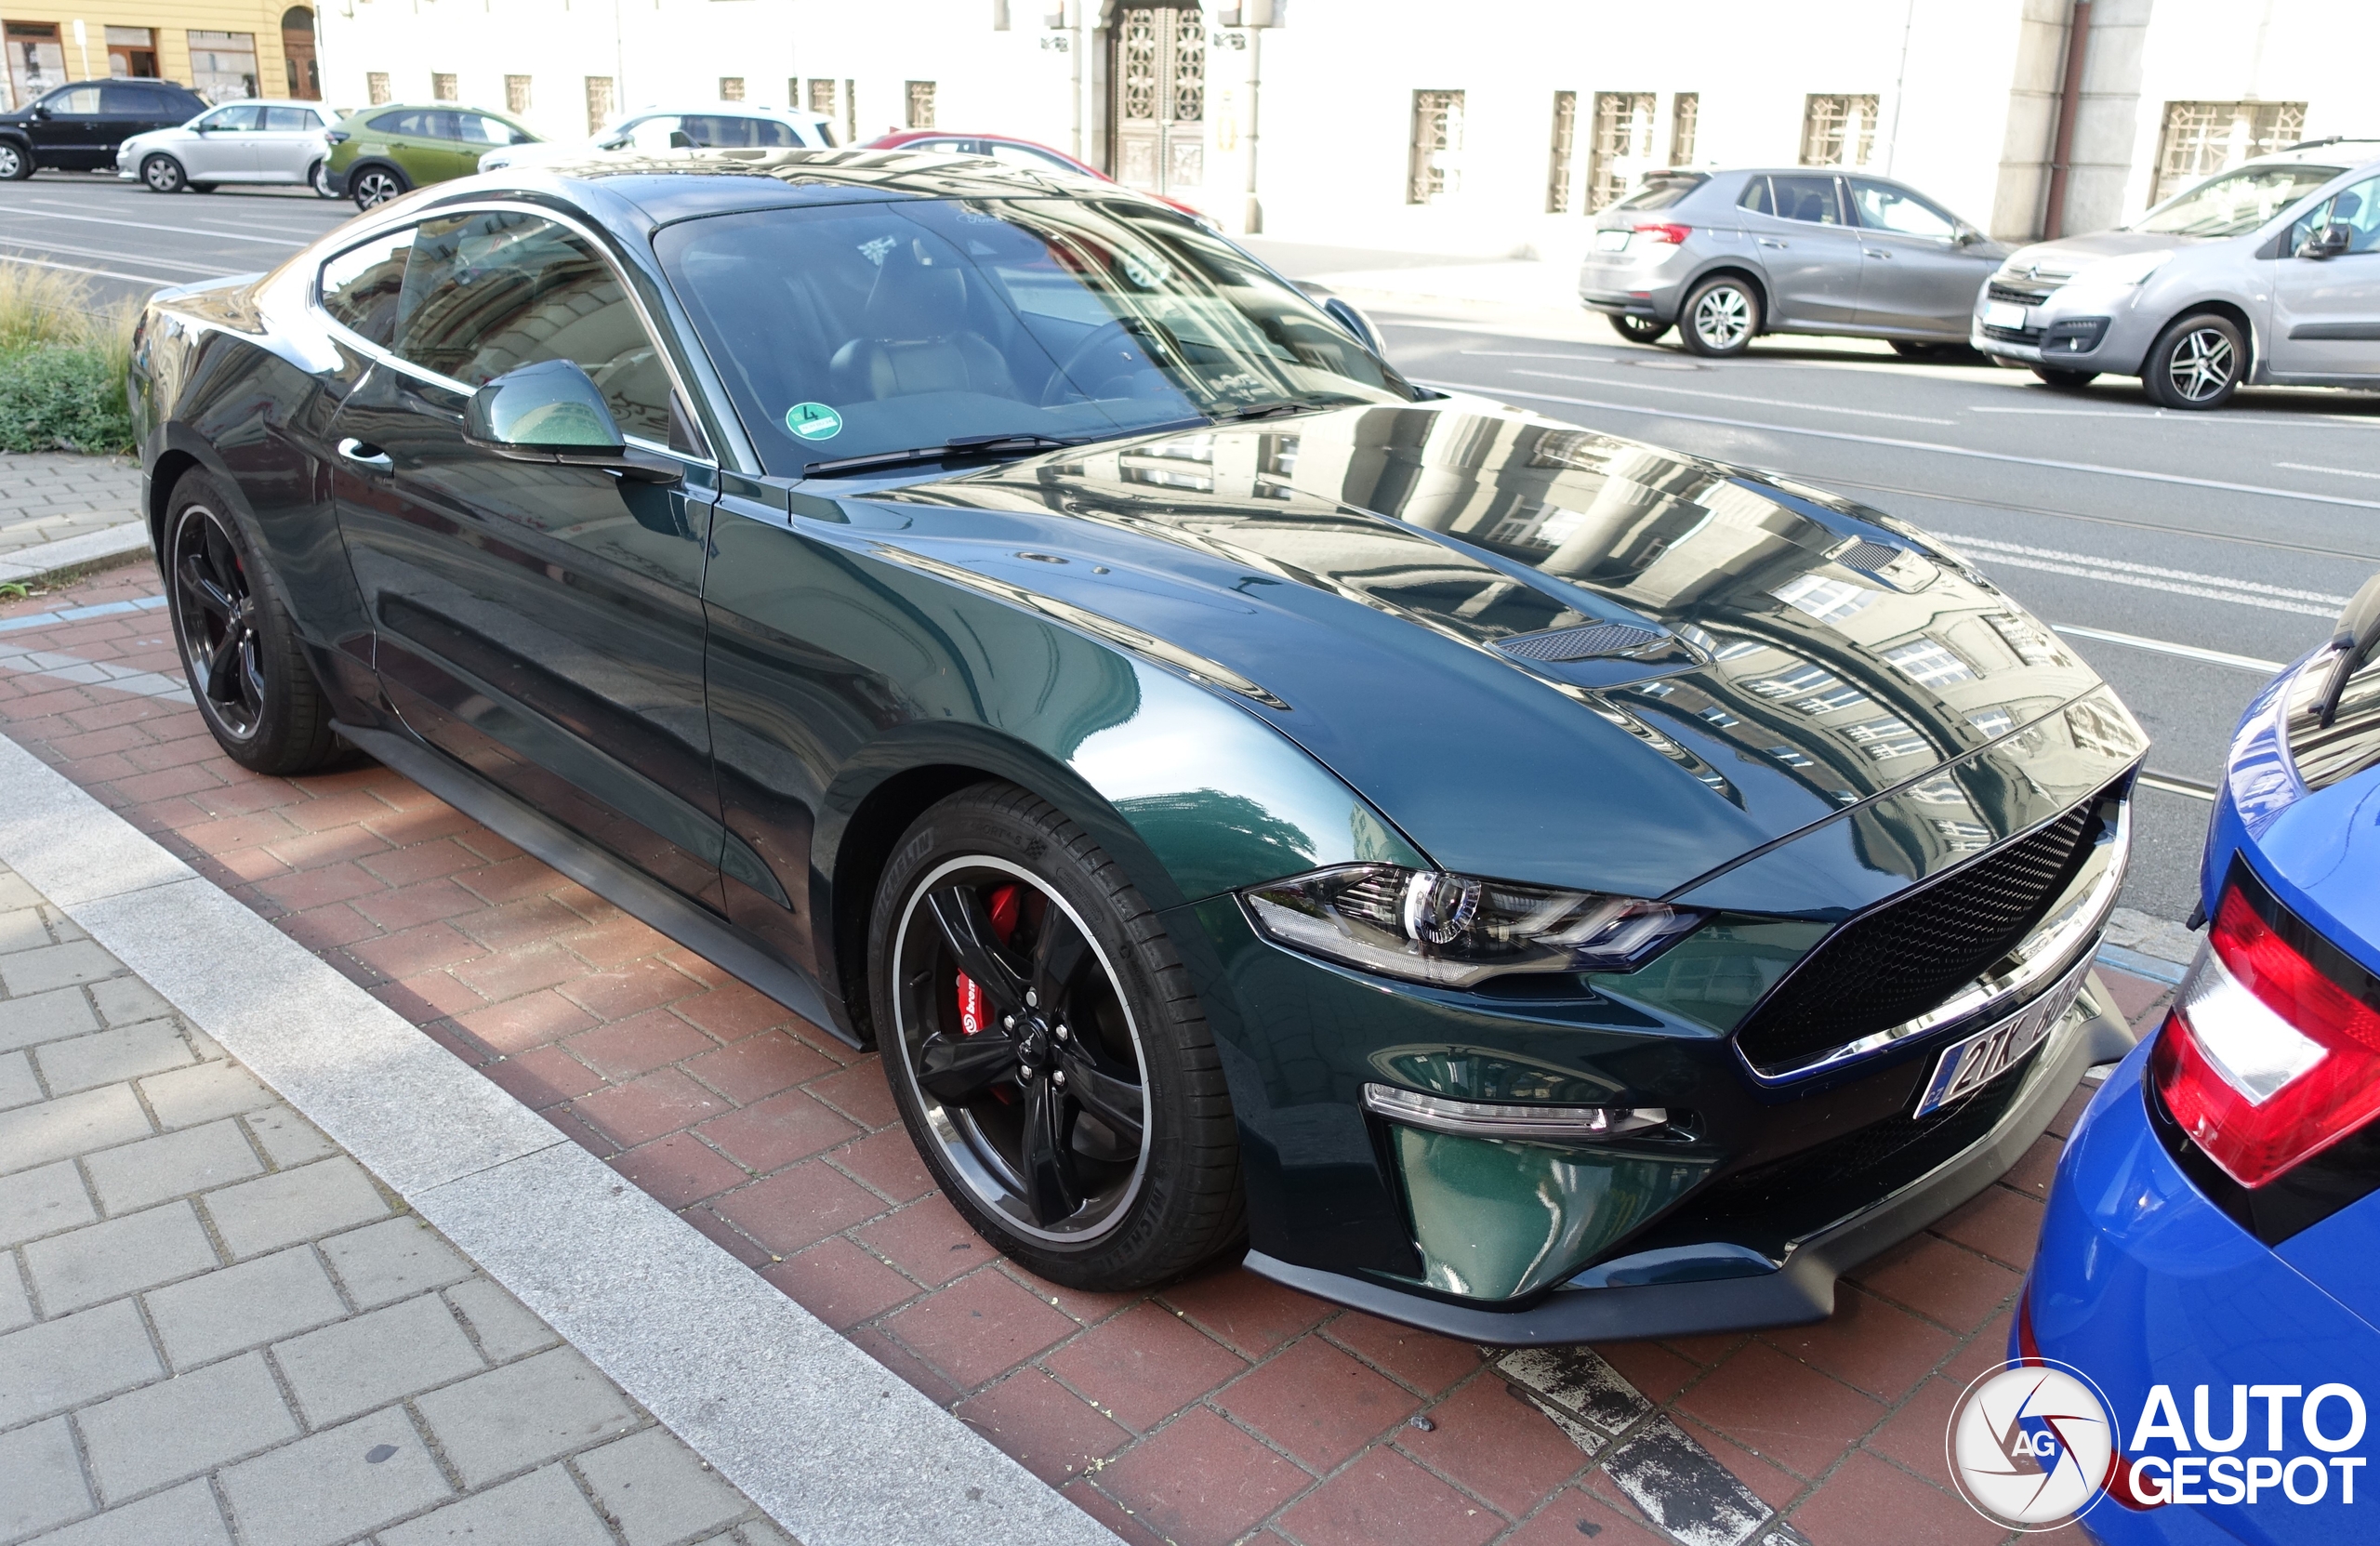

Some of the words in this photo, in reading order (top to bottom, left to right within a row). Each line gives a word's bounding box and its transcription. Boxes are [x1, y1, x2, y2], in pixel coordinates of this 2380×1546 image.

[803, 406, 818, 420] 4
[1949, 1013, 2029, 1096] 2TK
[1924, 1087, 1945, 1106] CZ
